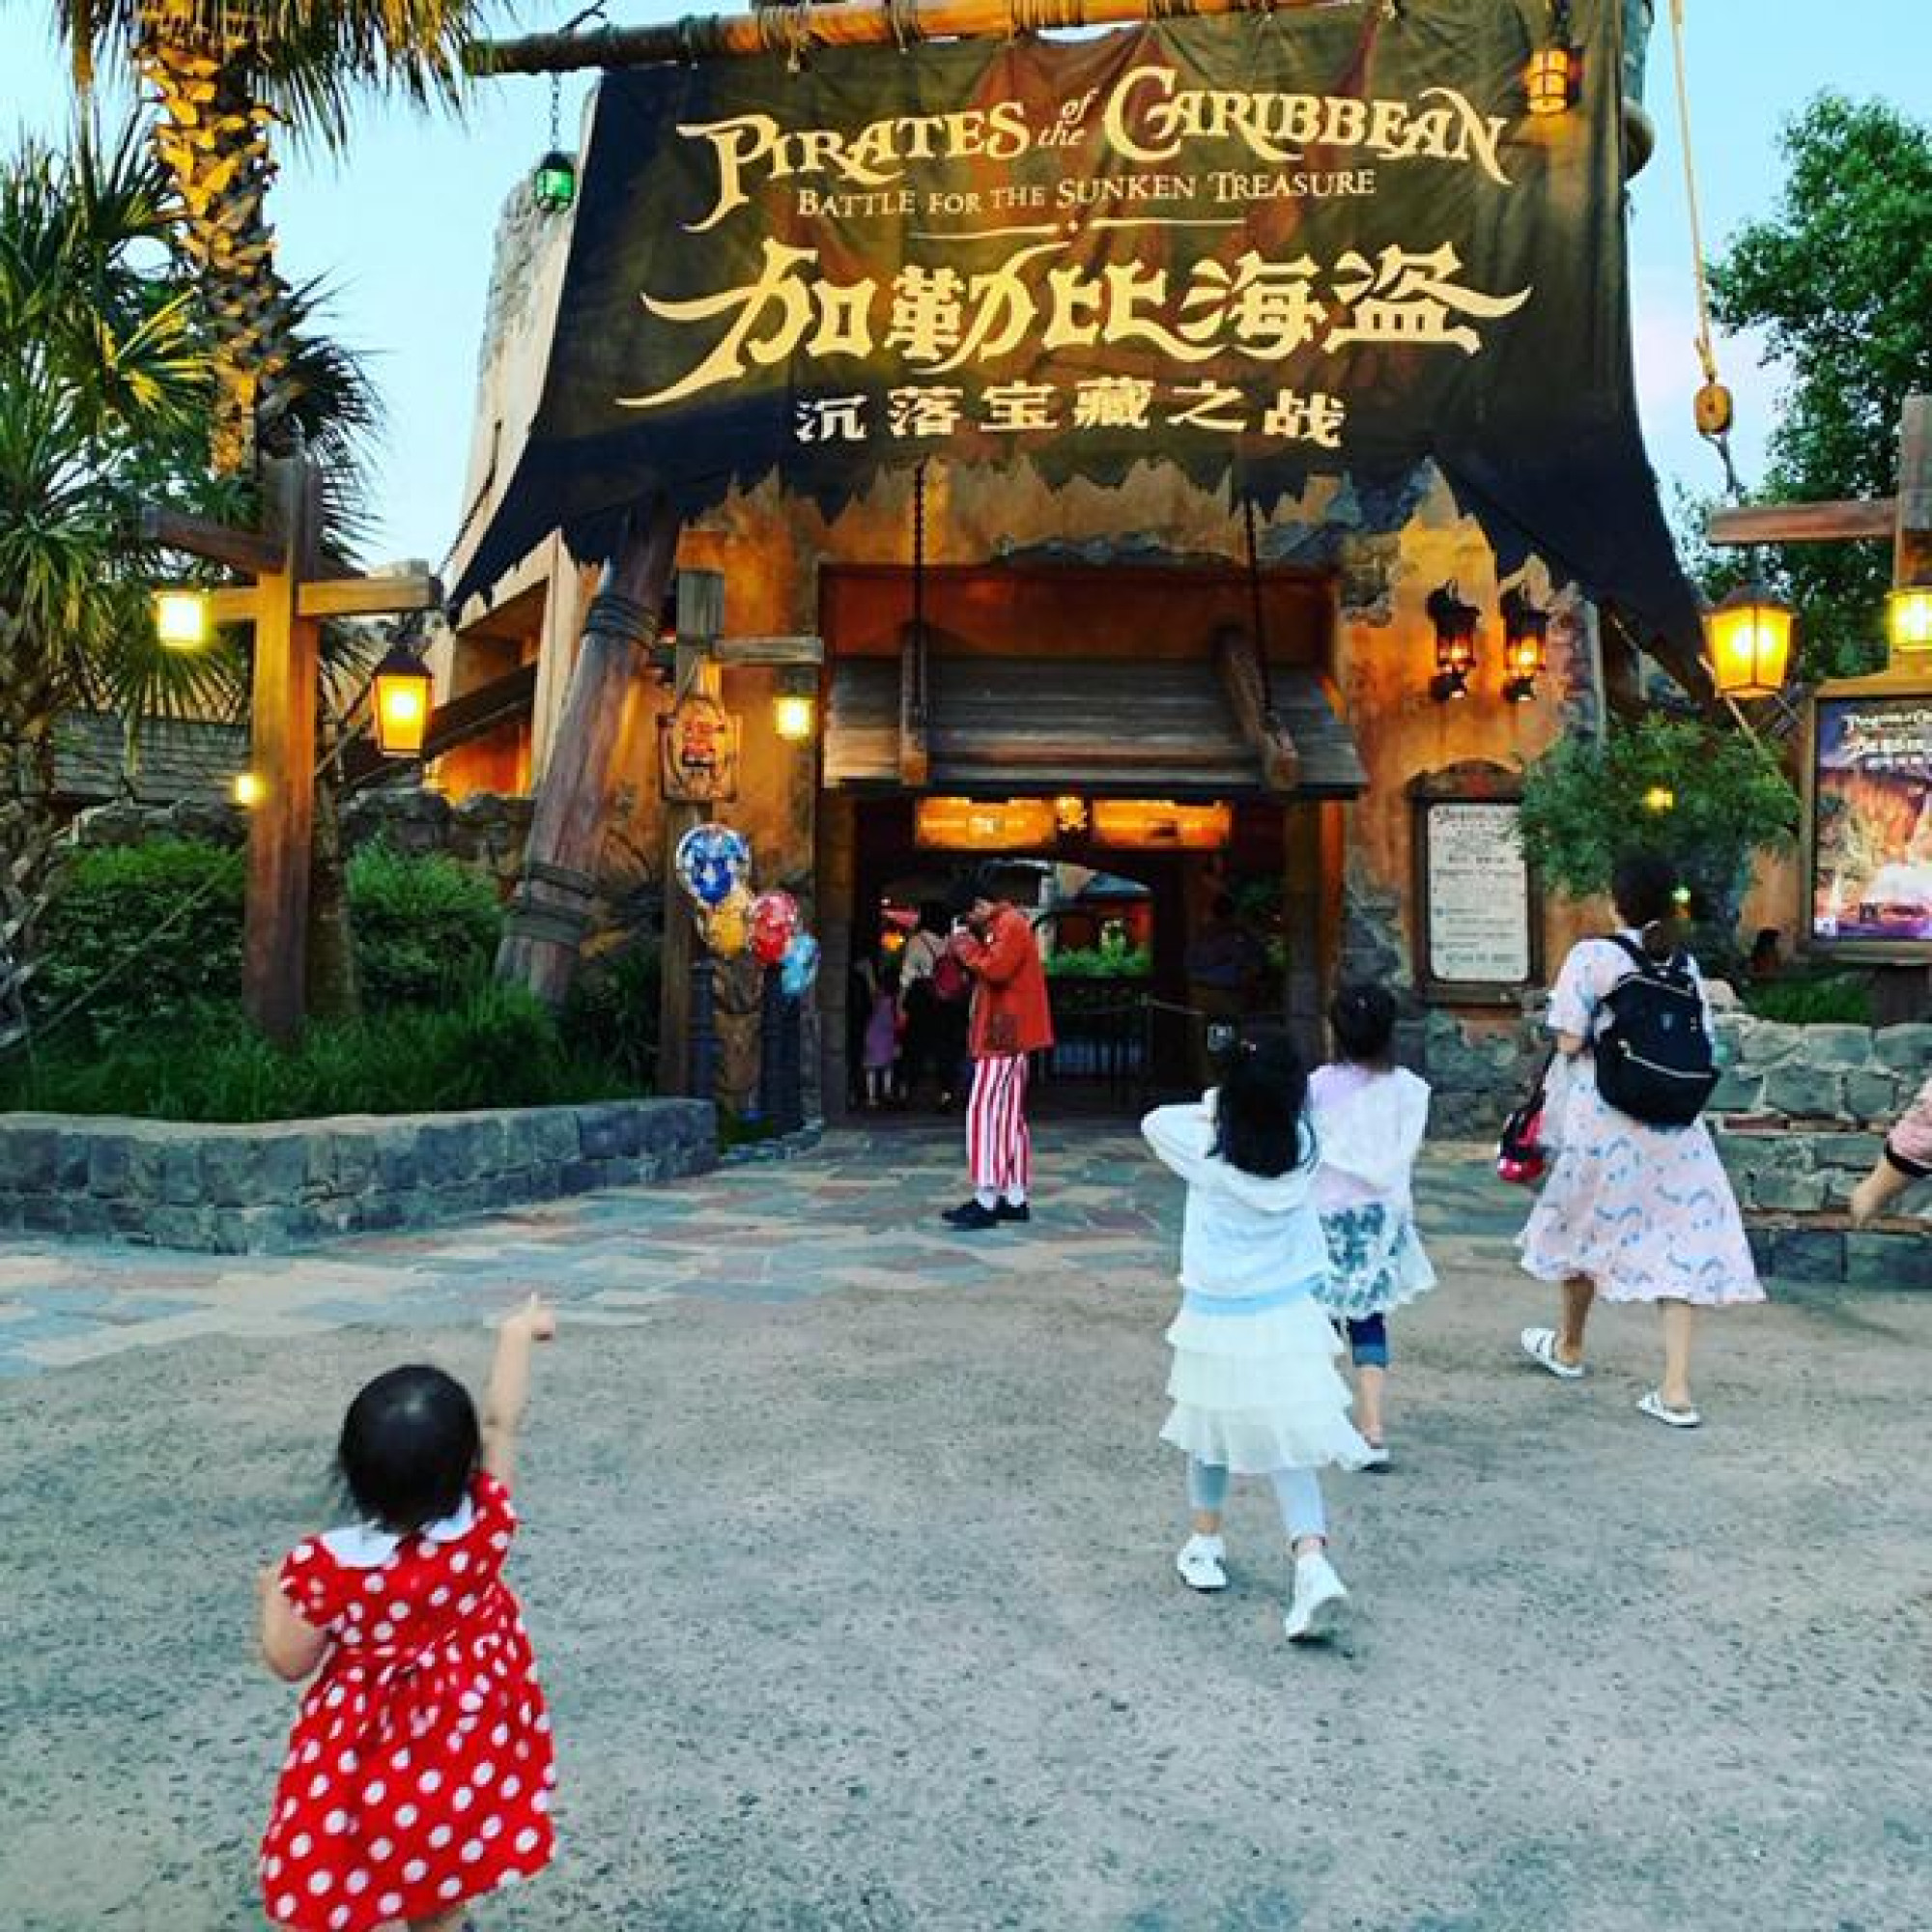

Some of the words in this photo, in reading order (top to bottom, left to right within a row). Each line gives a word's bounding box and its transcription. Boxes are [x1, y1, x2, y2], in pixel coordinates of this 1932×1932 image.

[1037, 119, 1088, 147] the
[1063, 88, 1099, 125] of
[1103, 66, 1513, 185] CARIBBEAN
[676, 101, 1031, 233] PIRATES
[797, 189, 916, 218] BATTLE
[928, 192, 981, 215] FOR
[989, 186, 1046, 209] THE
[1056, 174, 1196, 210] SUNKEN
[1208, 168, 1378, 204] TREASURE
[615, 239, 1533, 408] 加勒比海盗
[794, 378, 1349, 449] 沉落宝藏之战
